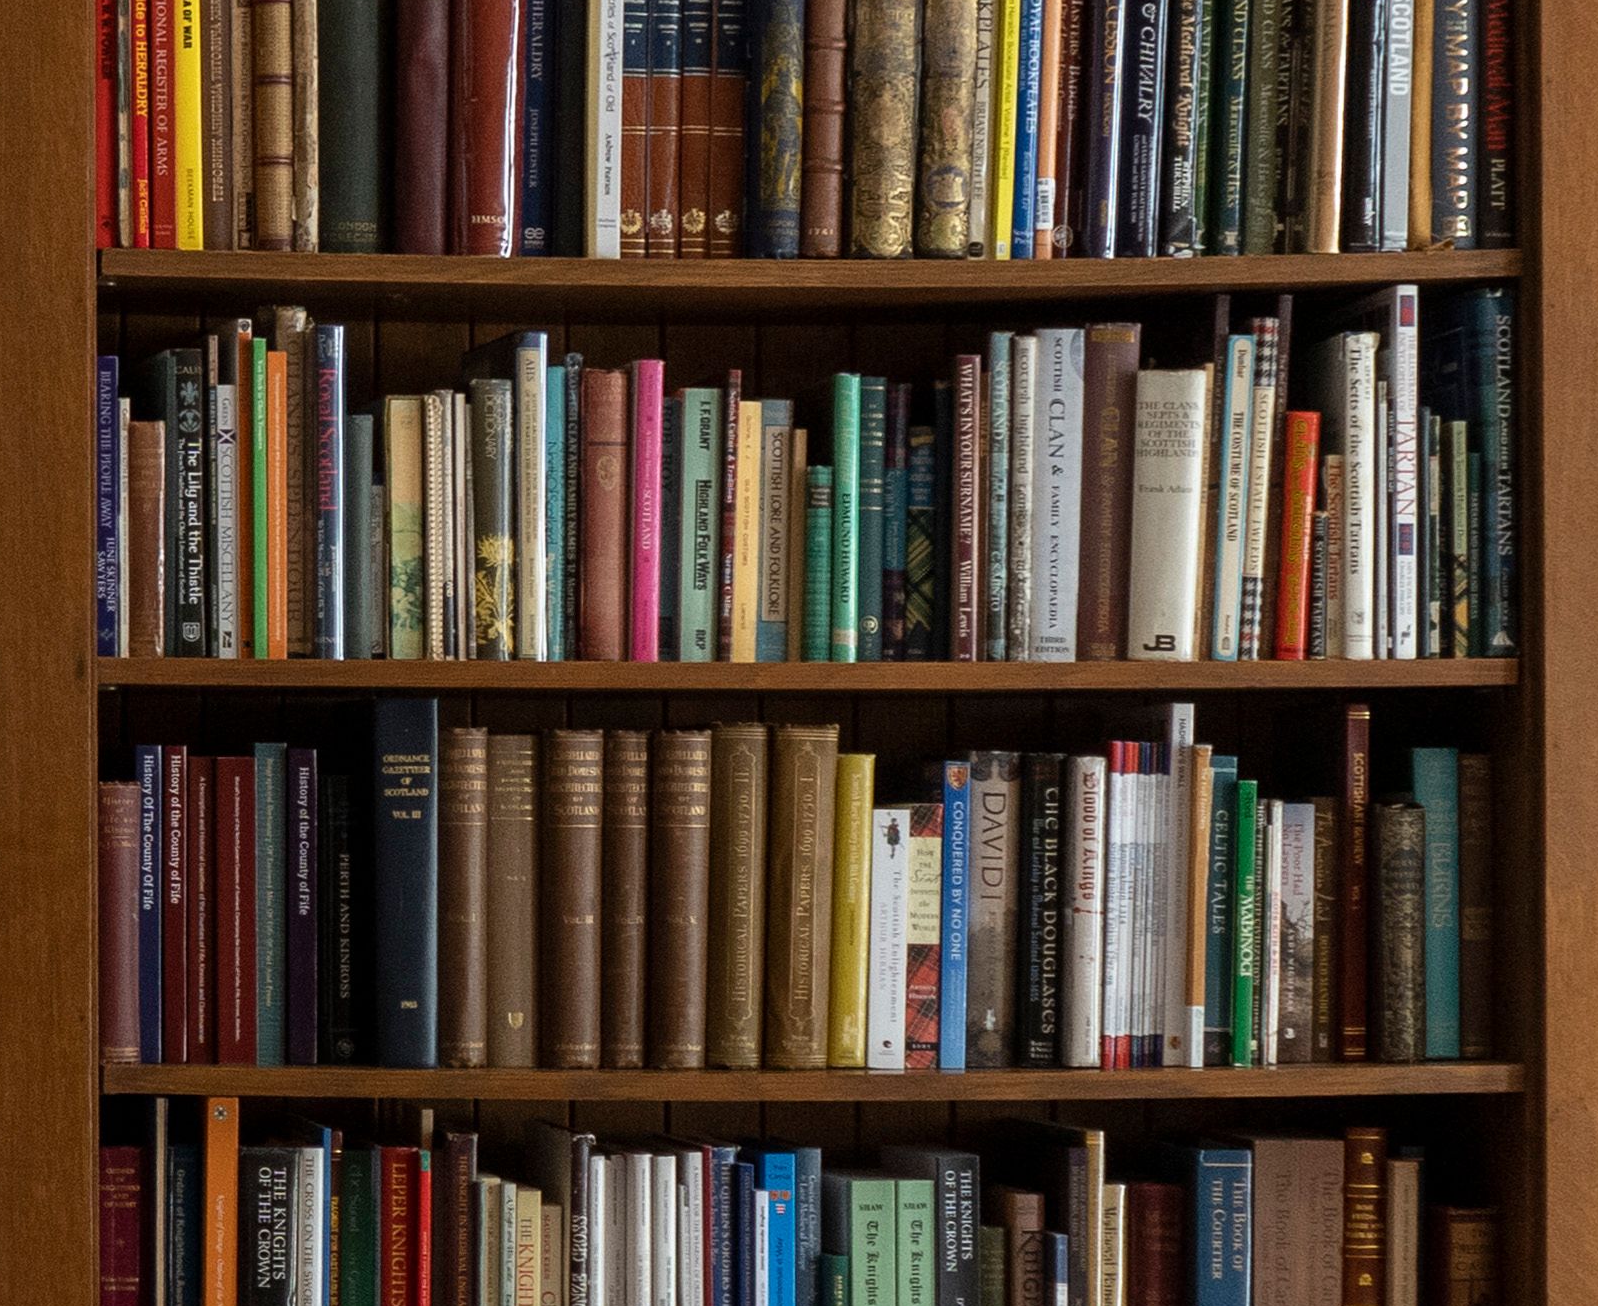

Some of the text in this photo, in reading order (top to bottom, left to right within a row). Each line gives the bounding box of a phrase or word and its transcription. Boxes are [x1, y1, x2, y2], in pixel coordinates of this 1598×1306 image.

[156, 49, 168, 111] REGISTER
[156, 115, 168, 133] OF
[156, 137, 168, 175] ARMS
[185, 439, 202, 603] The Lily and the Thistle
[297, 767, 310, 913] History of the County of Fife
[951, 801, 964, 961] CONQUERED BY NO ONE
[1212, 810, 1228, 934] CELTIC TALES
[258, 1167, 272, 1288] OF THE CROWN
[272, 1167, 286, 1279] THE KNIGHTS
[392, 1163, 406, 1217] LEPER
